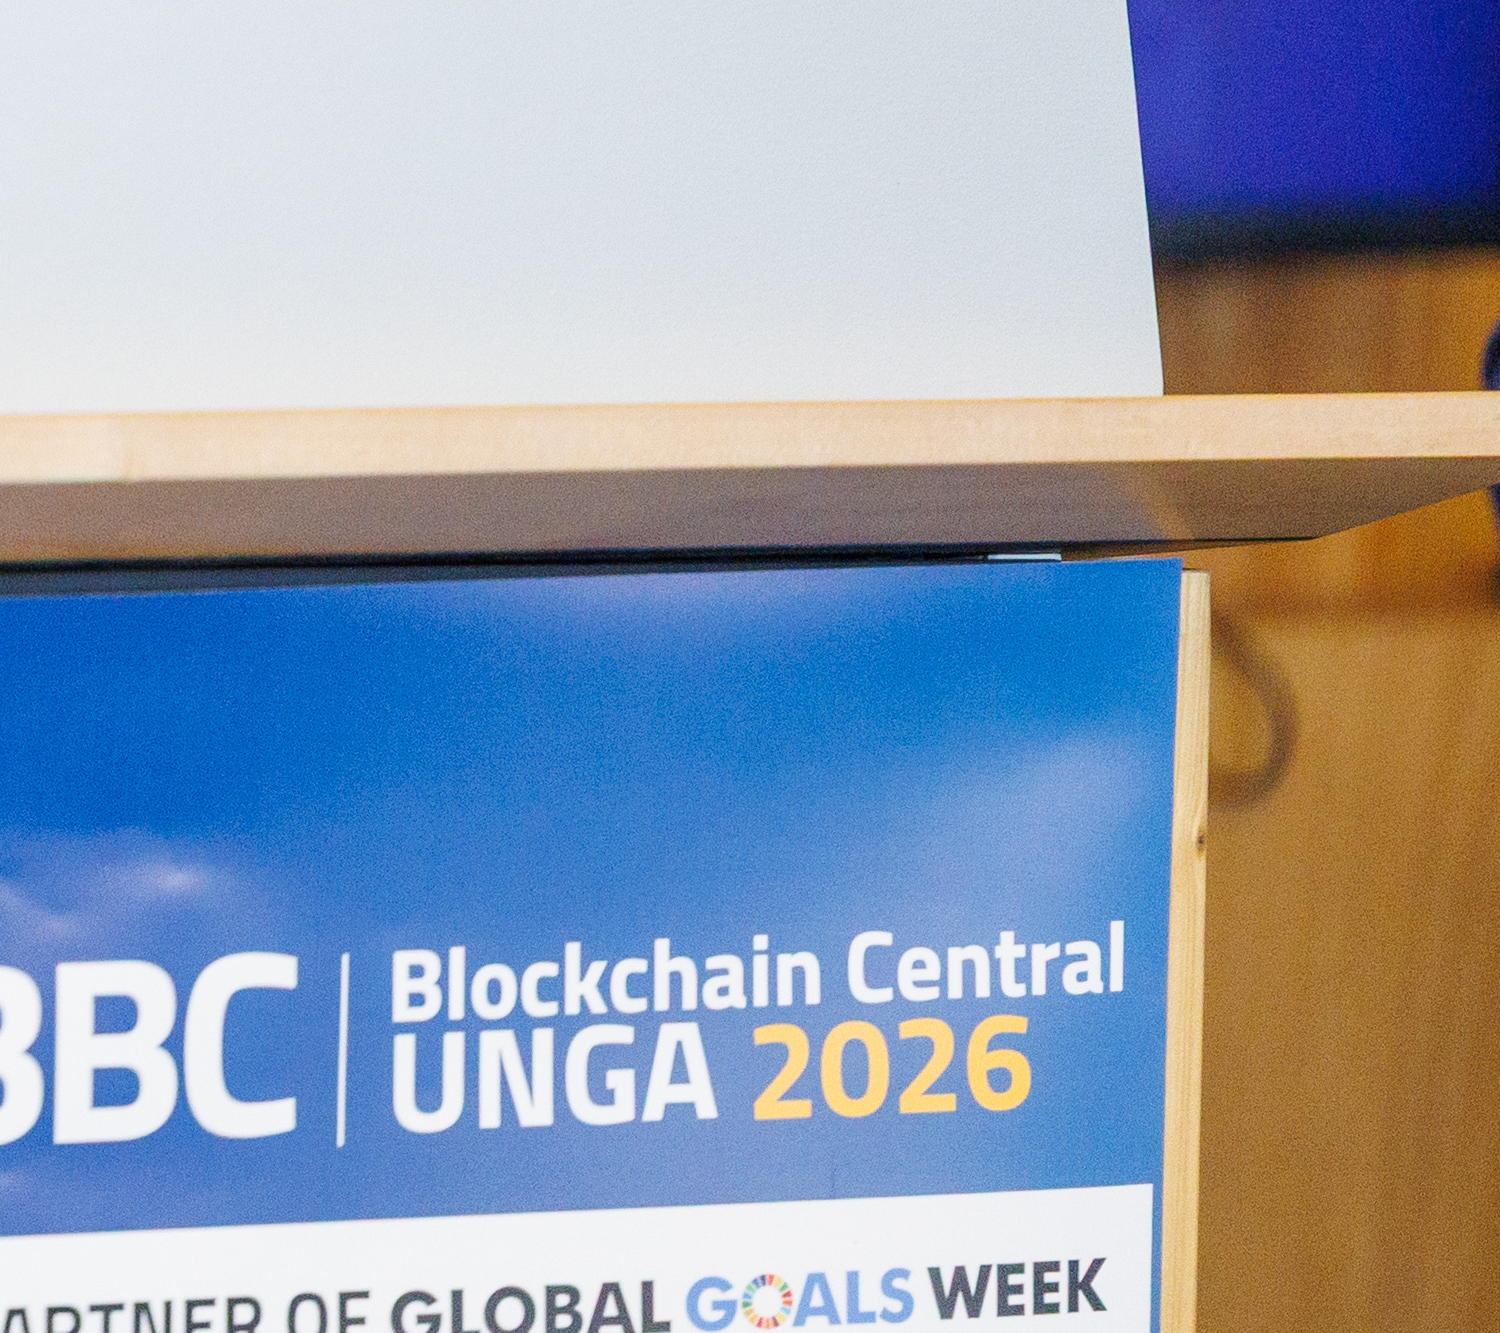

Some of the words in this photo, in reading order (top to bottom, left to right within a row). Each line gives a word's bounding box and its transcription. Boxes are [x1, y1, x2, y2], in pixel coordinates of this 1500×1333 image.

[391, 933, 822, 1023] Blockchain
[846, 919, 1126, 1004] Central
[391, 1020, 719, 1135] UNGA
[751, 1014, 1033, 1121] 2026
[285, 1289, 371, 1333] OF
[389, 1279, 672, 1333] GLOBAL
[685, 1266, 915, 1333] GOALS
[926, 1256, 1109, 1321] WEEK
